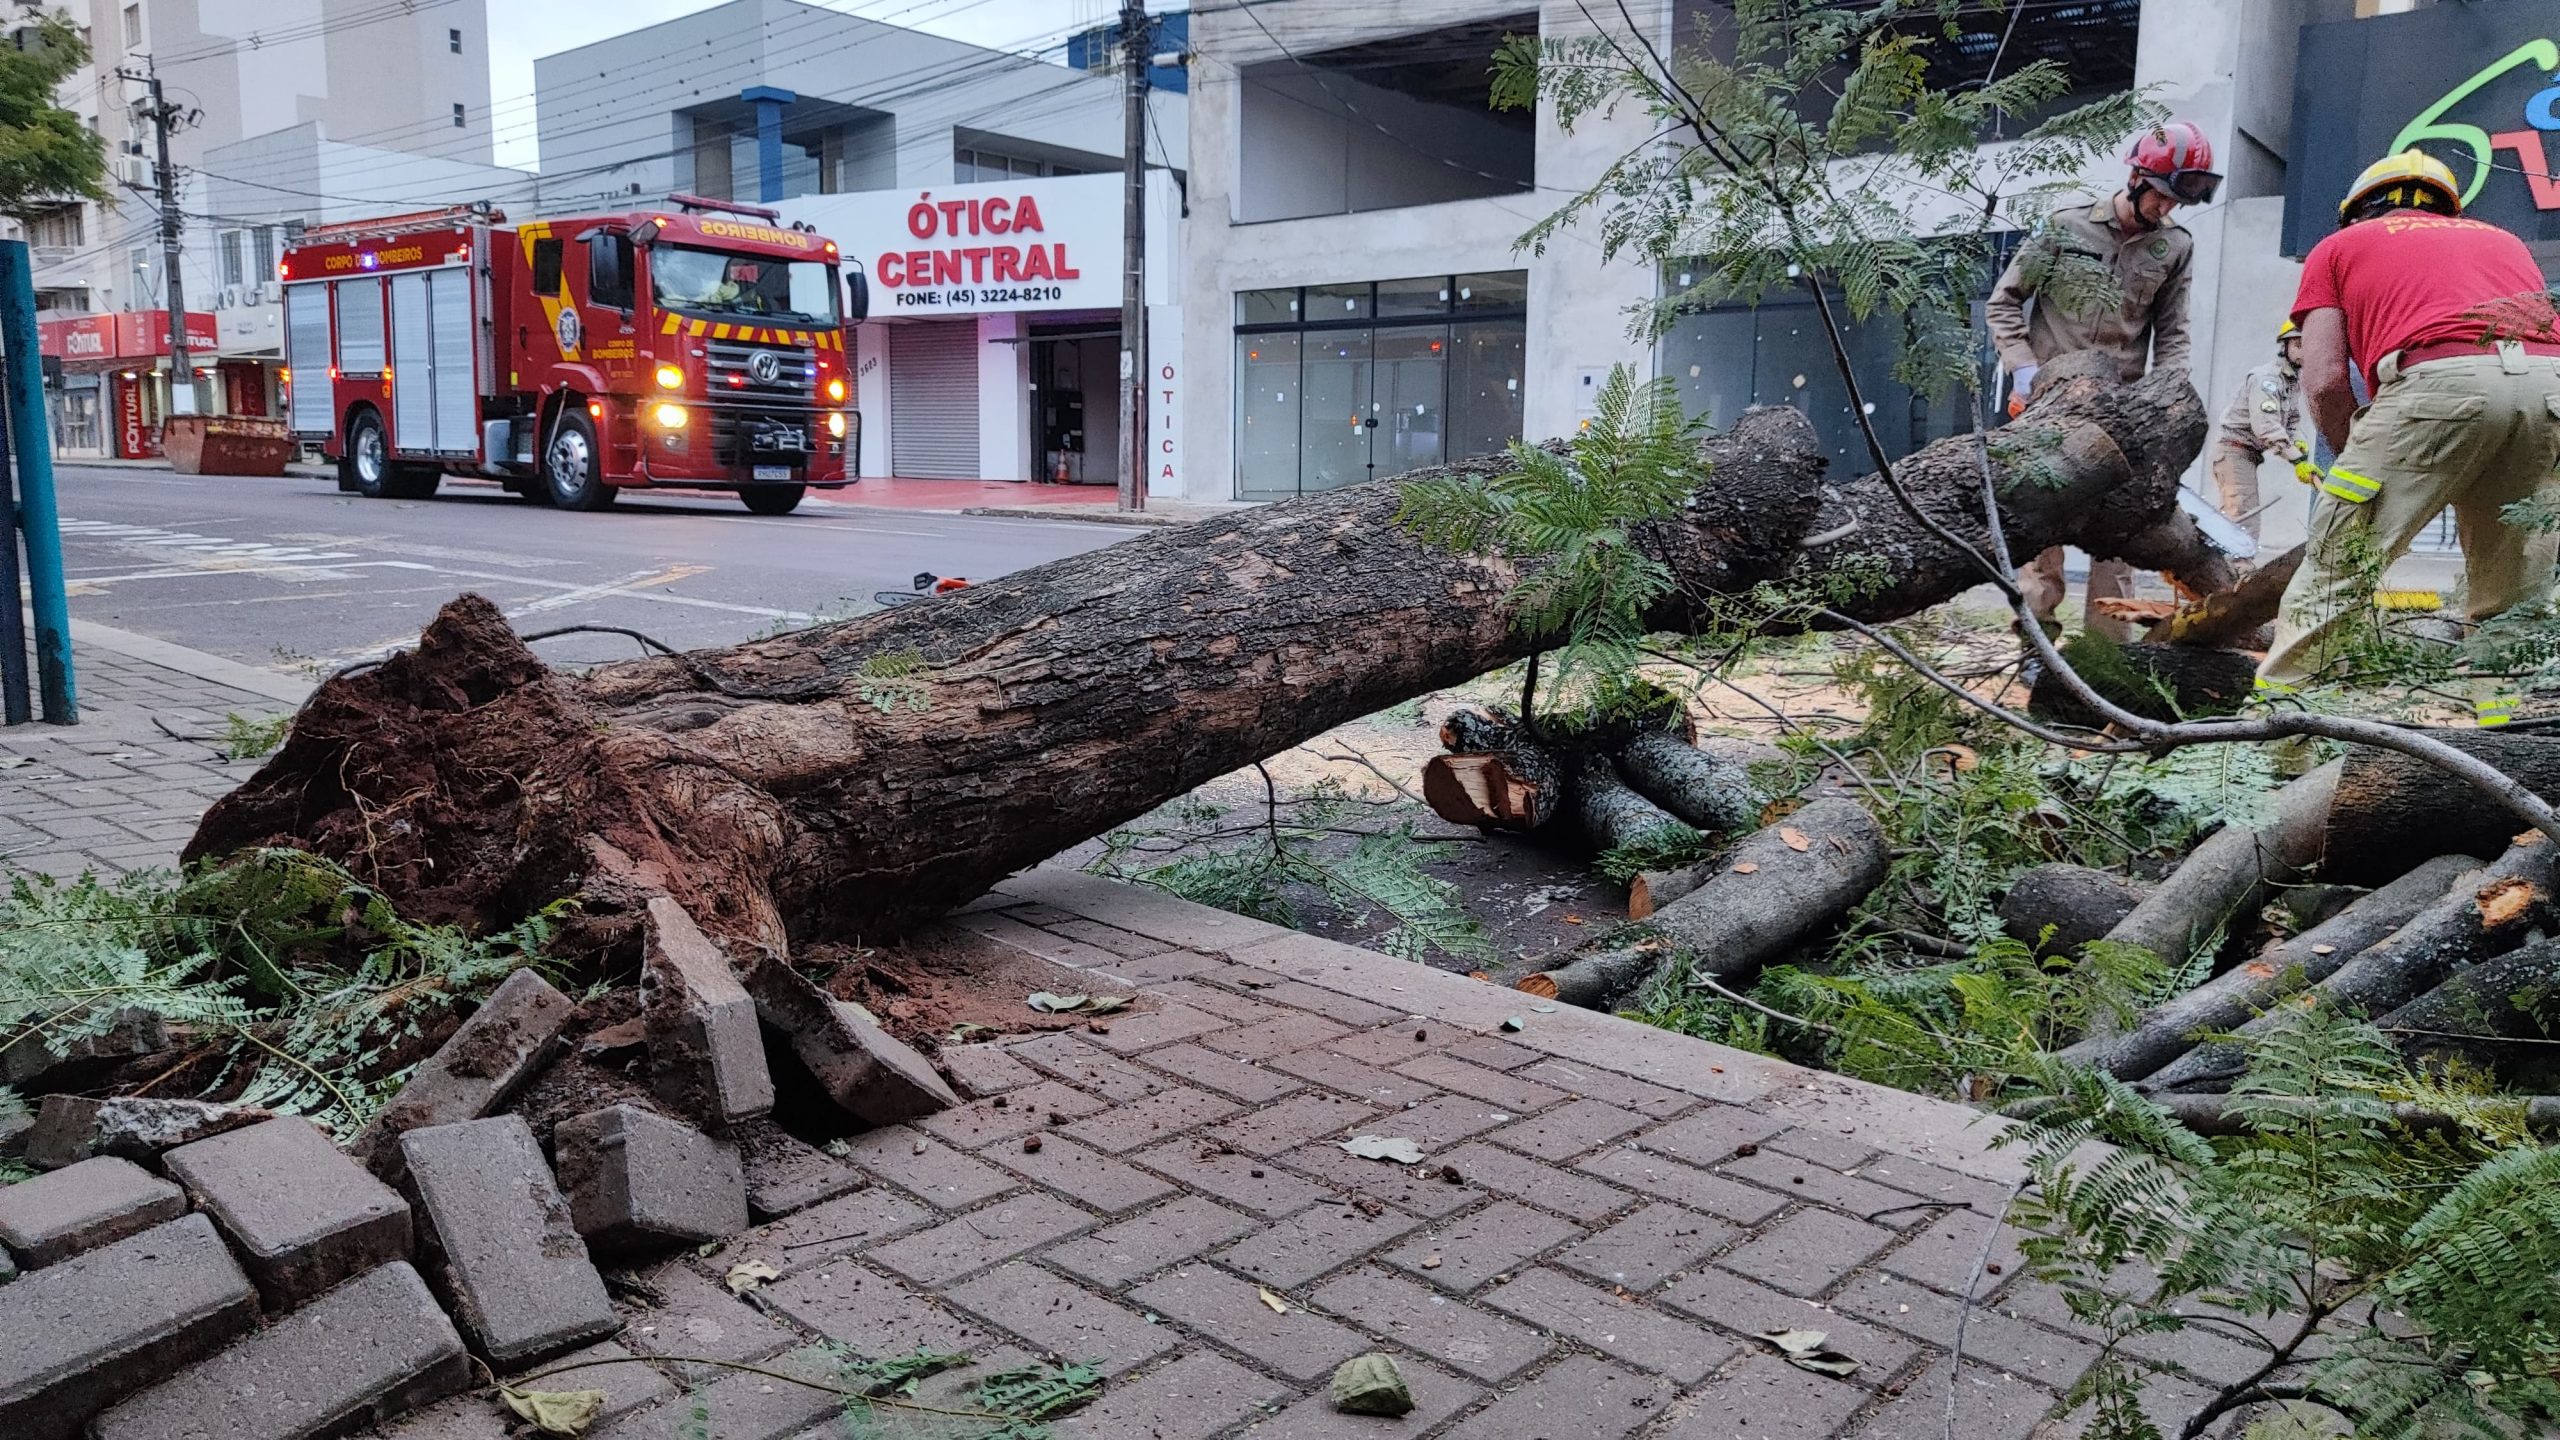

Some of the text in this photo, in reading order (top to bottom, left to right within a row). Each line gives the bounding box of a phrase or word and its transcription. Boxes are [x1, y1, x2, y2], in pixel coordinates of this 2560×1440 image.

[908, 192, 1043, 239] ÓTICA
[325, 255, 353, 270] CORPO
[374, 246, 423, 265] BOMBEIROS
[877, 243, 1080, 288] CENTRAL
[896, 286, 1061, 307] FONE: (45) 3224-8210
[125, 384, 140, 454] PONTUAL
[1162, 362, 1175, 478] ÓTICA
